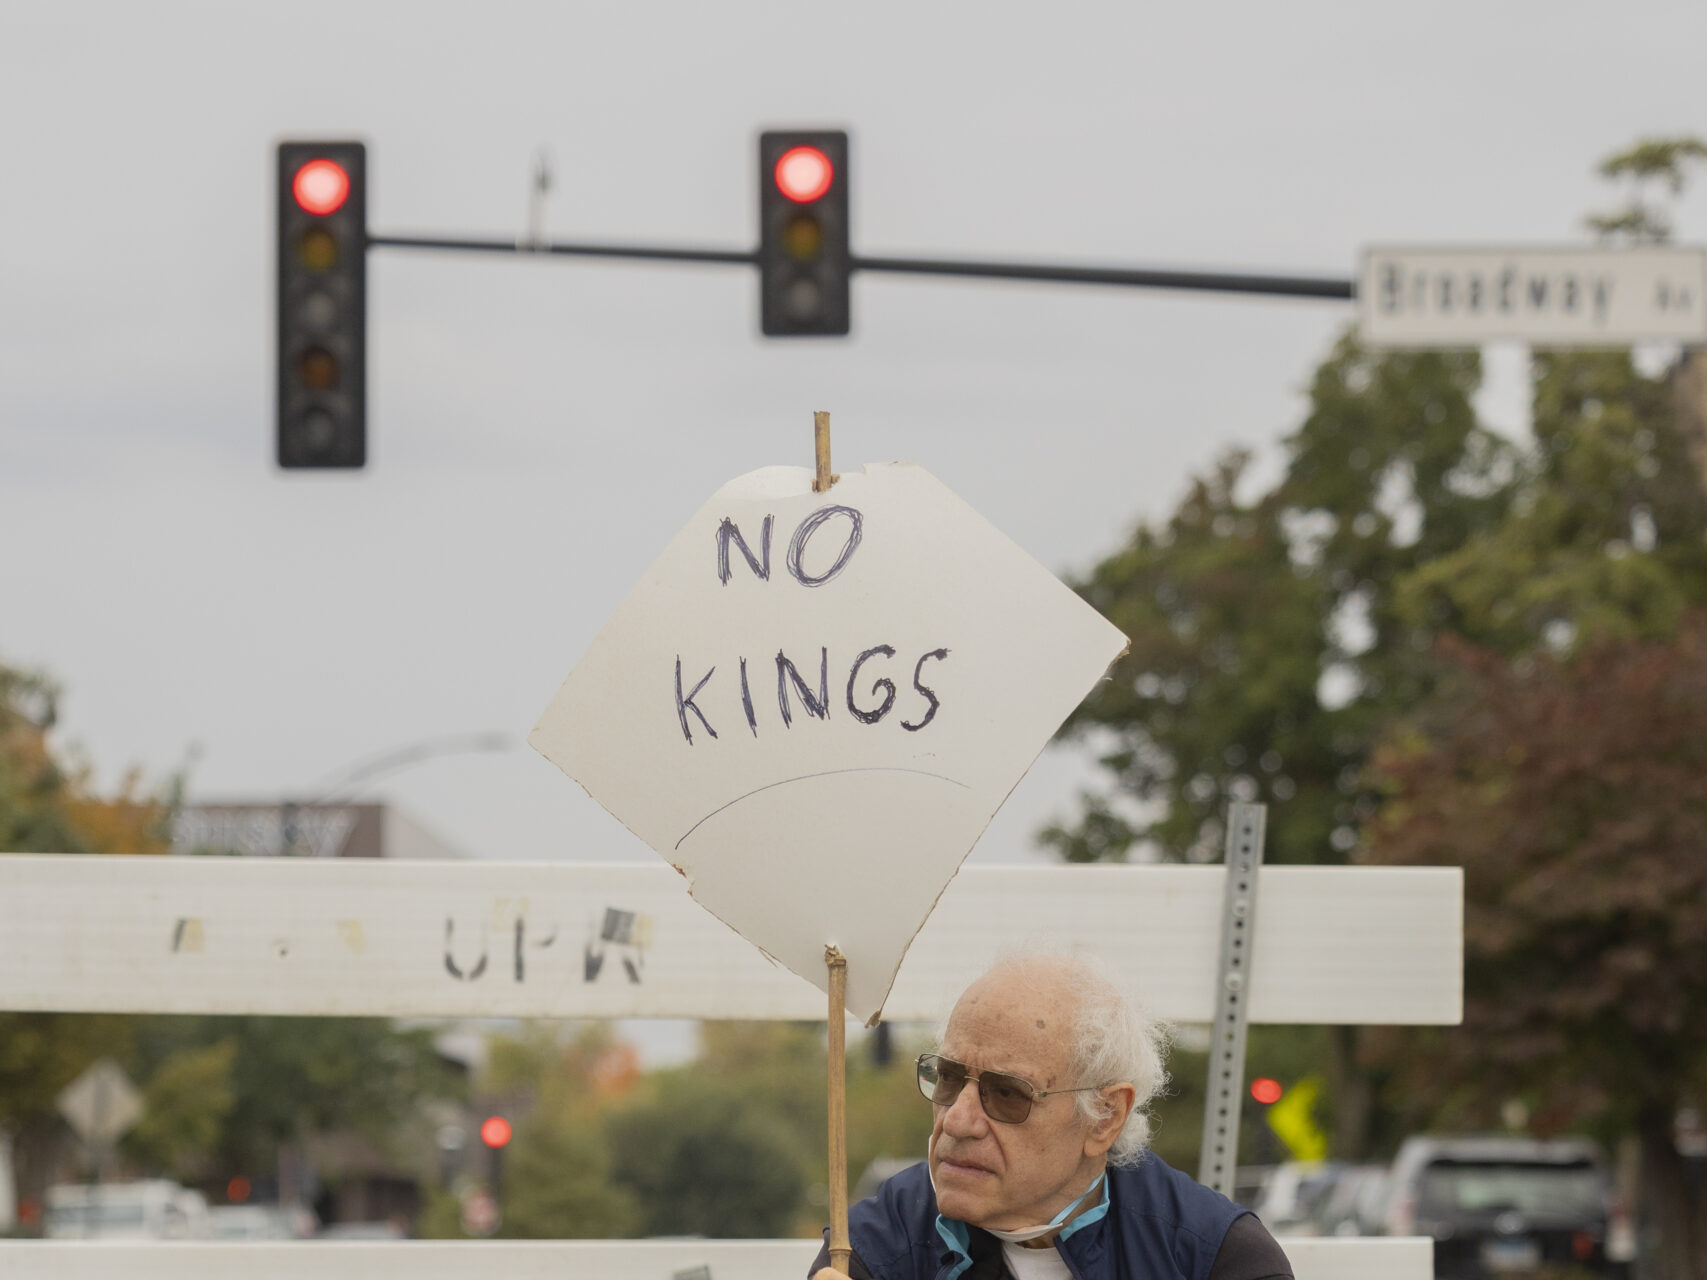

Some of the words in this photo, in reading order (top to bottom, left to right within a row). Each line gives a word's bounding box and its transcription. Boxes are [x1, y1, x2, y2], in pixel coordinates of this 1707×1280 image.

[1379, 262, 1613, 325] Broadway
[716, 504, 863, 587] NO
[674, 645, 951, 745] KINGS
